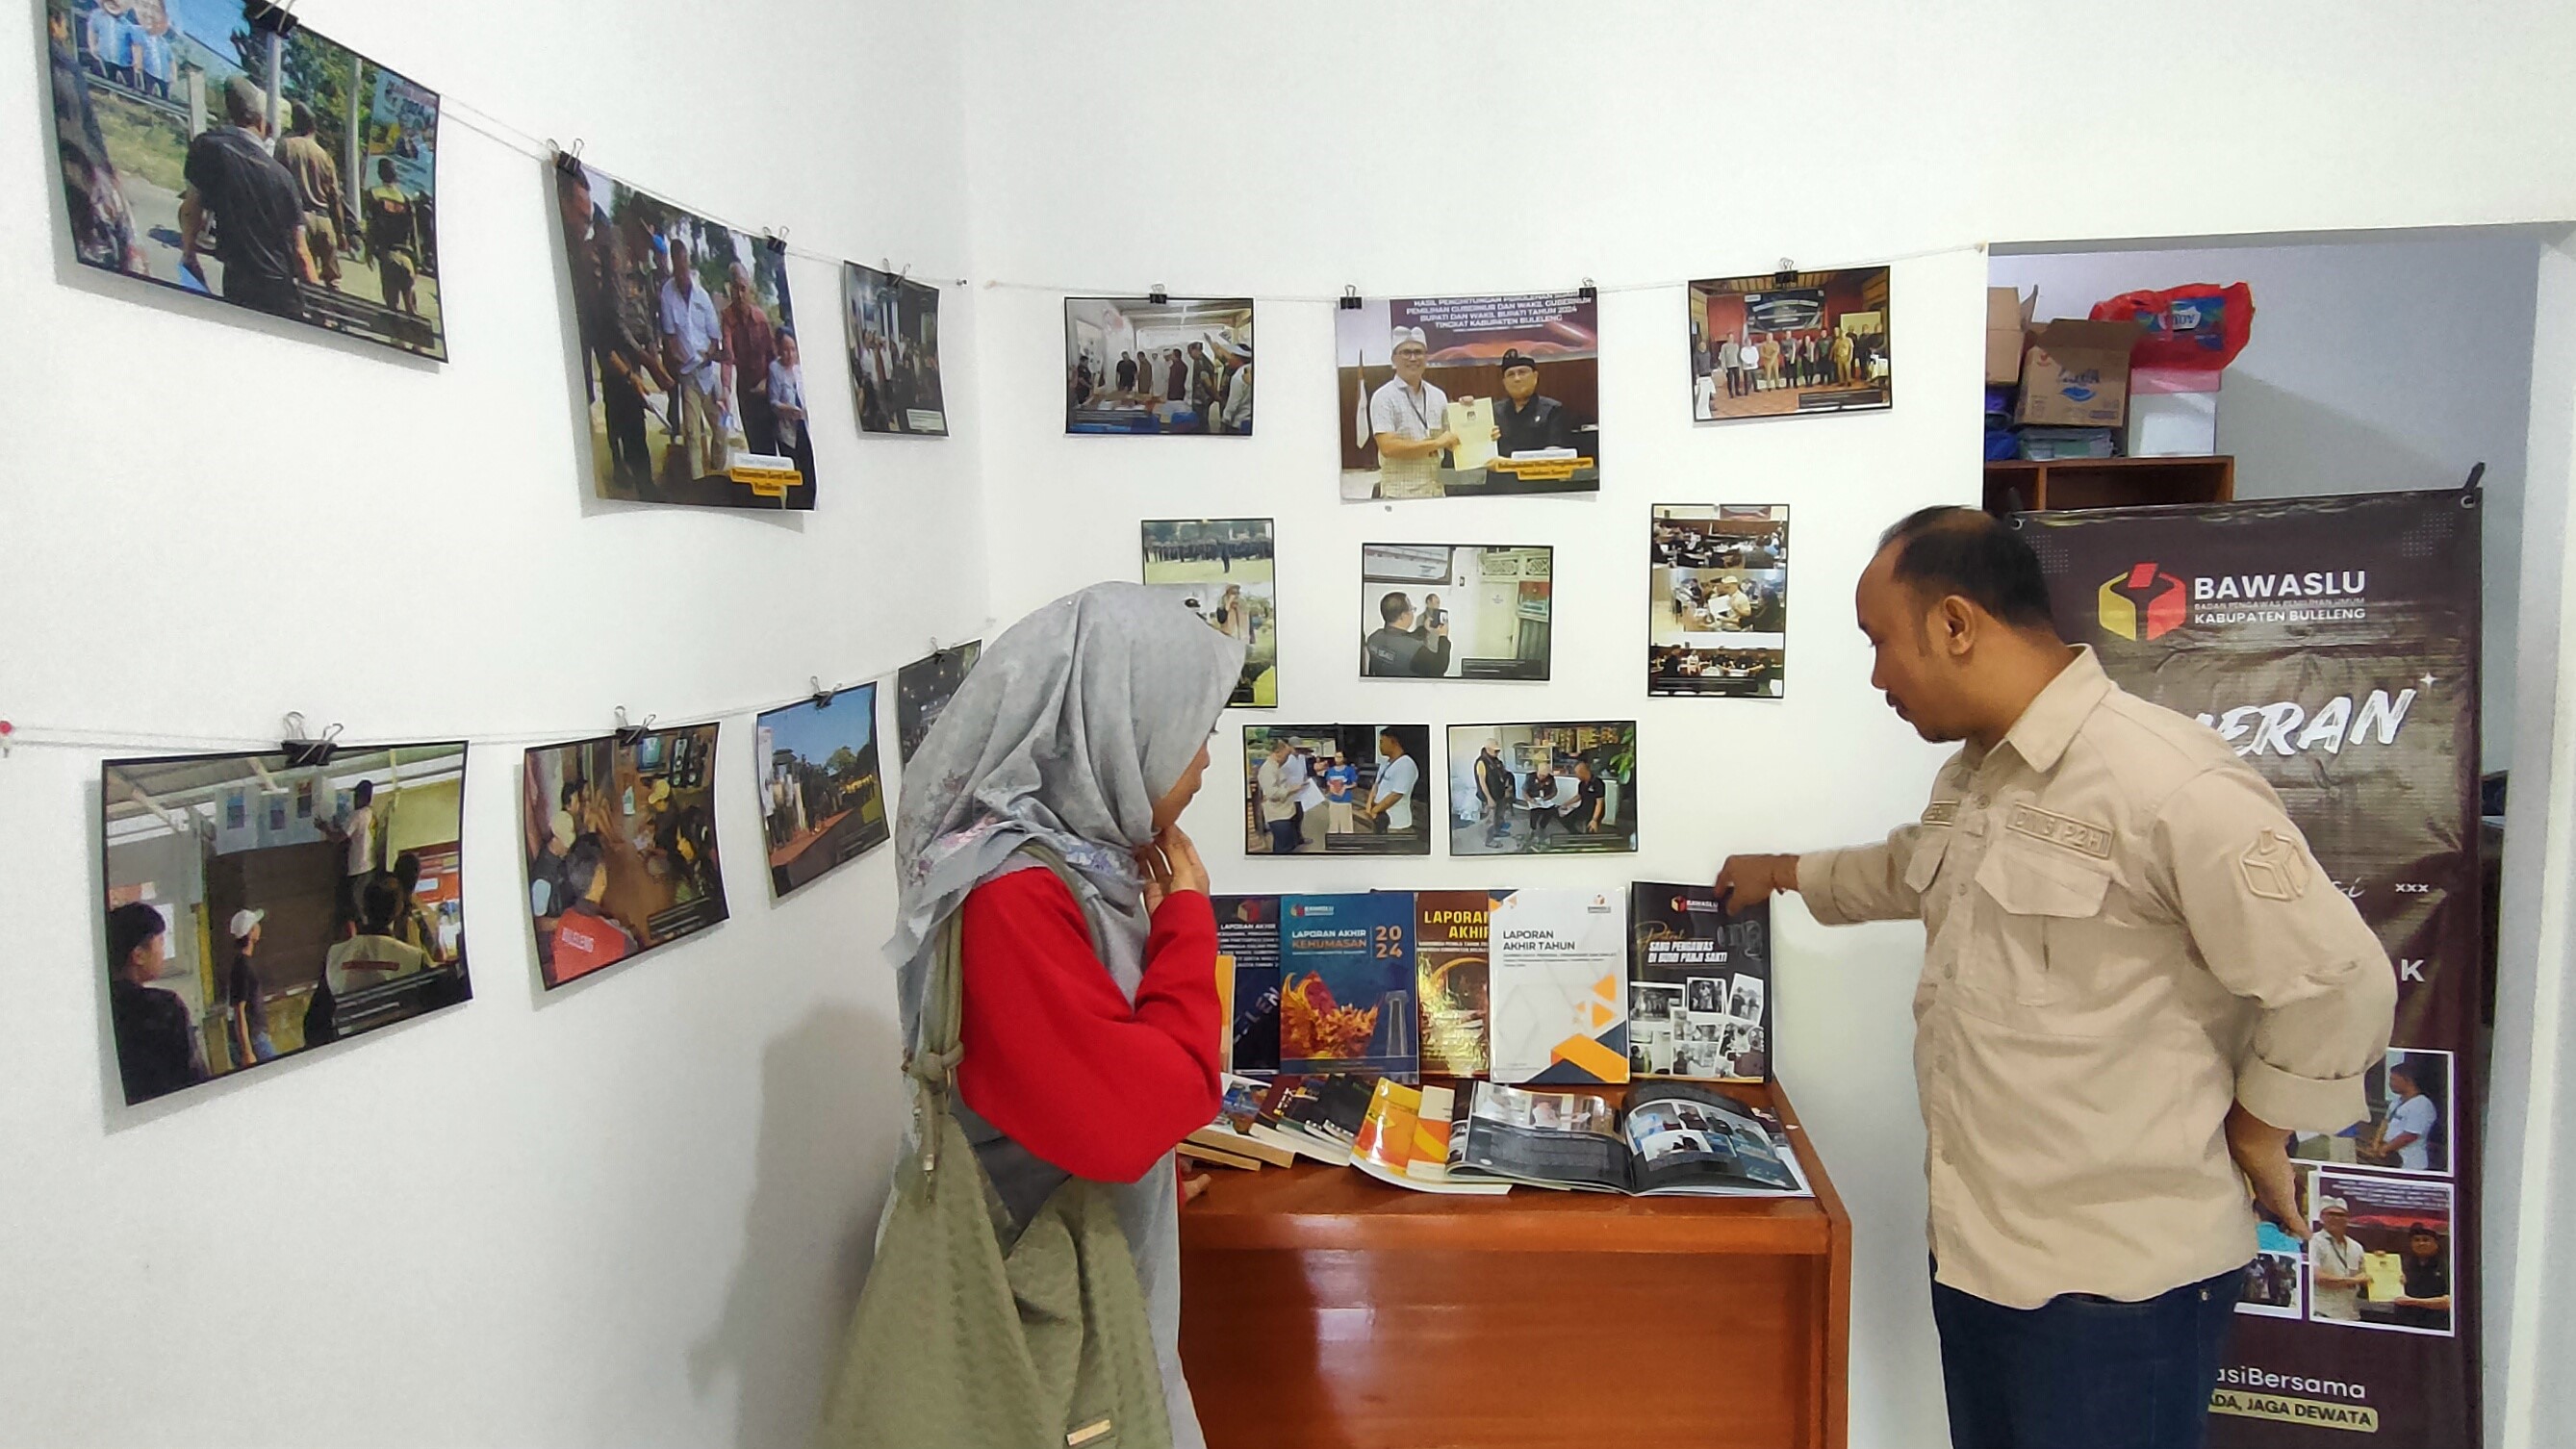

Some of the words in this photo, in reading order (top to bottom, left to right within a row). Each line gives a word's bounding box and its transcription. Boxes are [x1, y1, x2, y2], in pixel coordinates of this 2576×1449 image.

[2195, 571, 2365, 600] BAWASLU
[2194, 611, 2285, 624] KABUPATEN
[2289, 608, 2365, 621] BULELENG
[2195, 688, 2417, 756] ERAN
[1292, 929, 1336, 938] LAPORAN
[1375, 925, 1402, 941] 20
[1503, 930, 1554, 939] LAPORAN
[1292, 939, 1366, 949] KEHUMASAN
[1375, 943, 1403, 958] 24
[1503, 942, 1536, 951] AKHIR
[1539, 941, 1575, 950] TAHUN
[2401, 958, 2425, 981] K
[2247, 1398, 2290, 1415] JAGA
[2294, 1404, 2372, 1426] DEWATA
